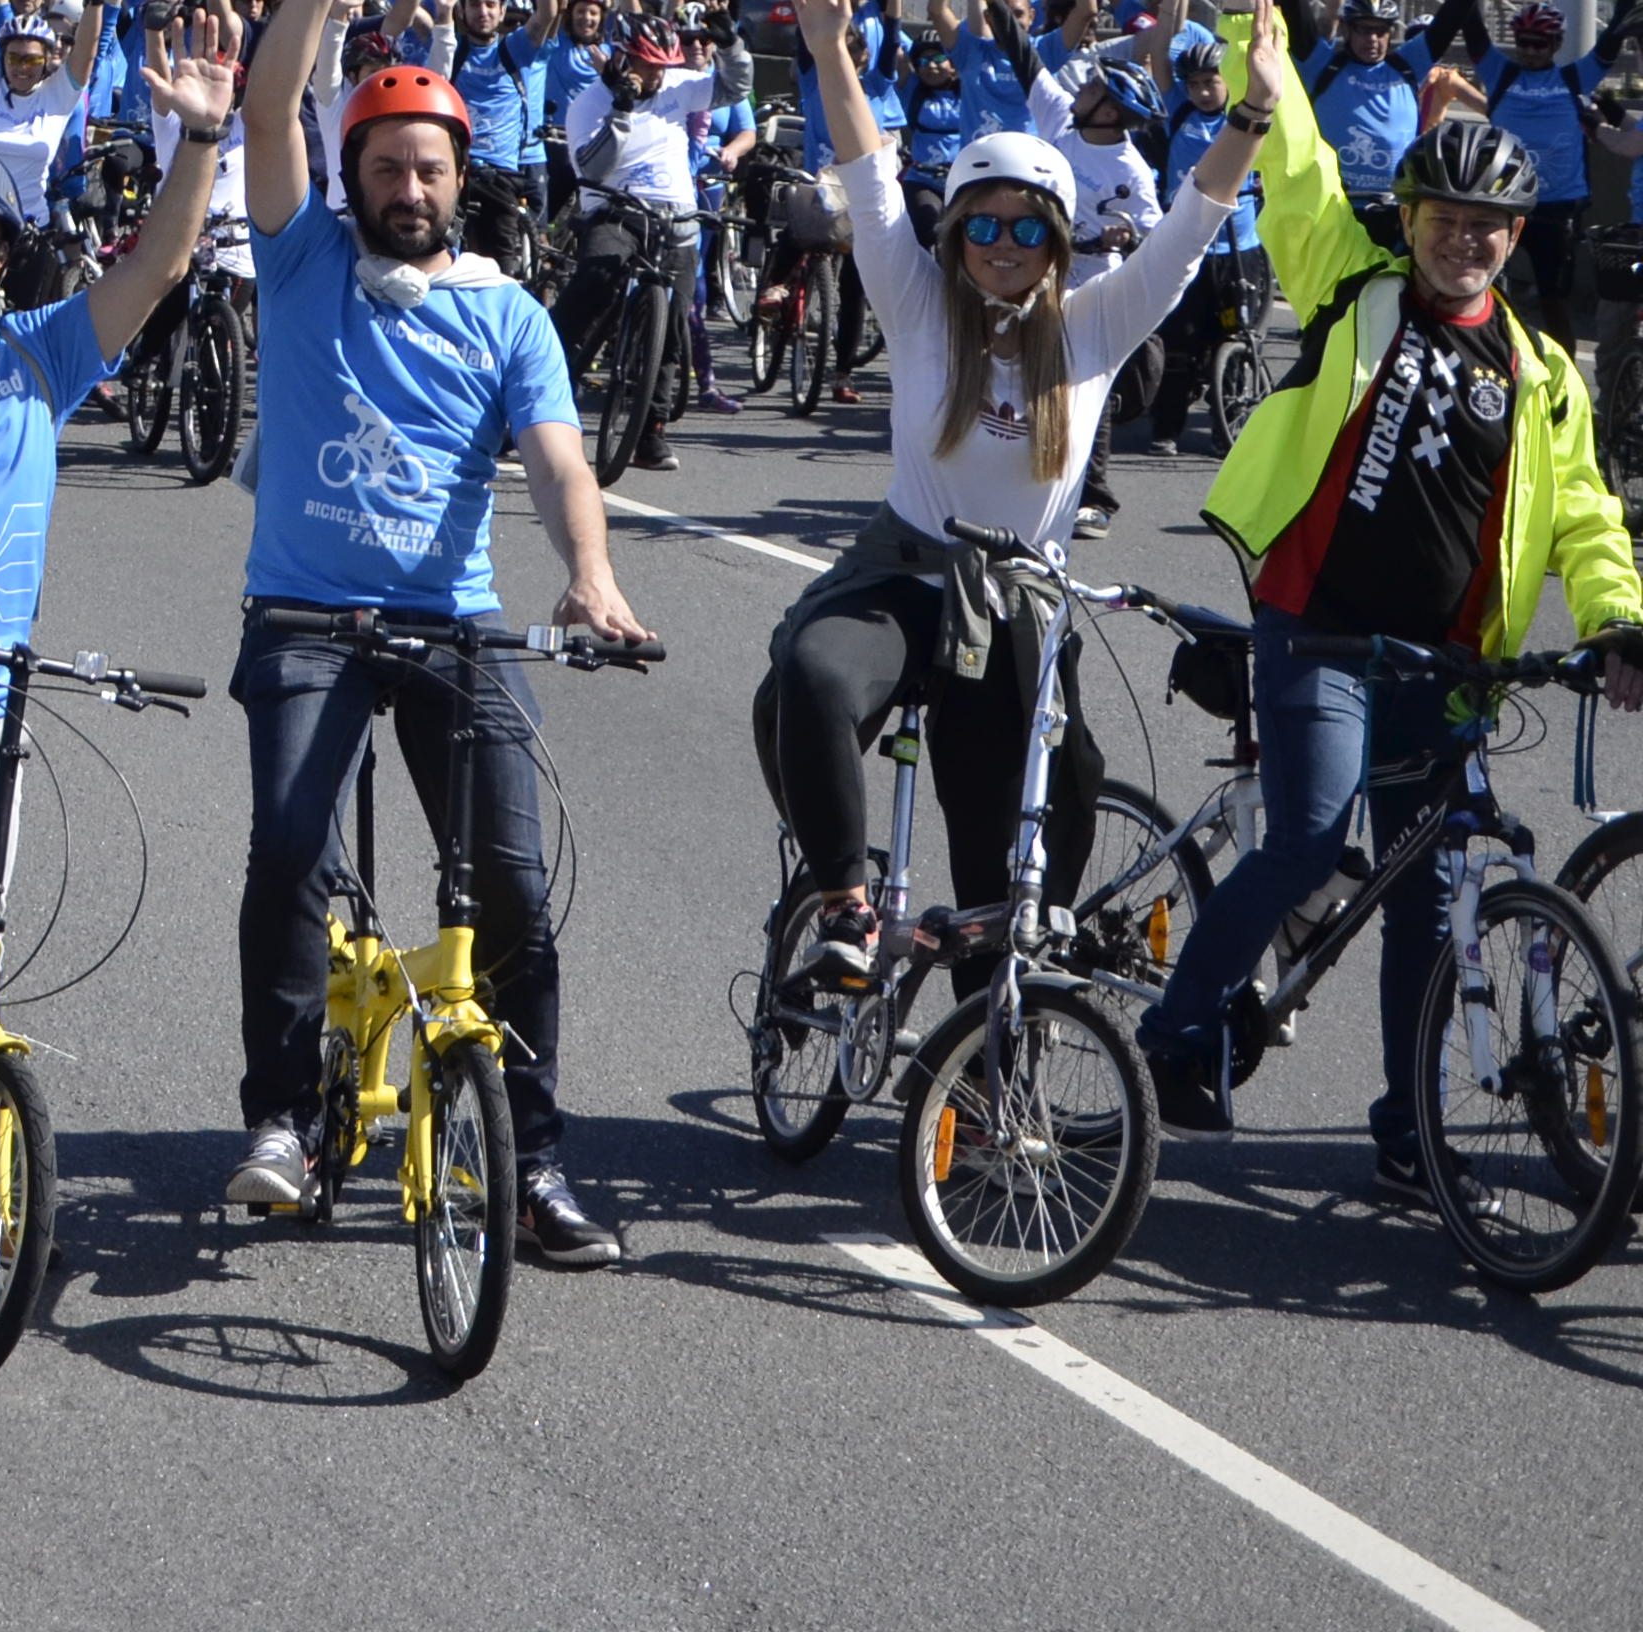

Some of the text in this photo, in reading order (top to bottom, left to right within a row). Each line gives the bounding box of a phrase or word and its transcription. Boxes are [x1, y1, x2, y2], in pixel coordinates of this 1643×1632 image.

[1348, 320, 1427, 513] AMSTERDAM
[303, 499, 437, 540] BICICLETEADA
[347, 526, 443, 558] FAMILIAR
